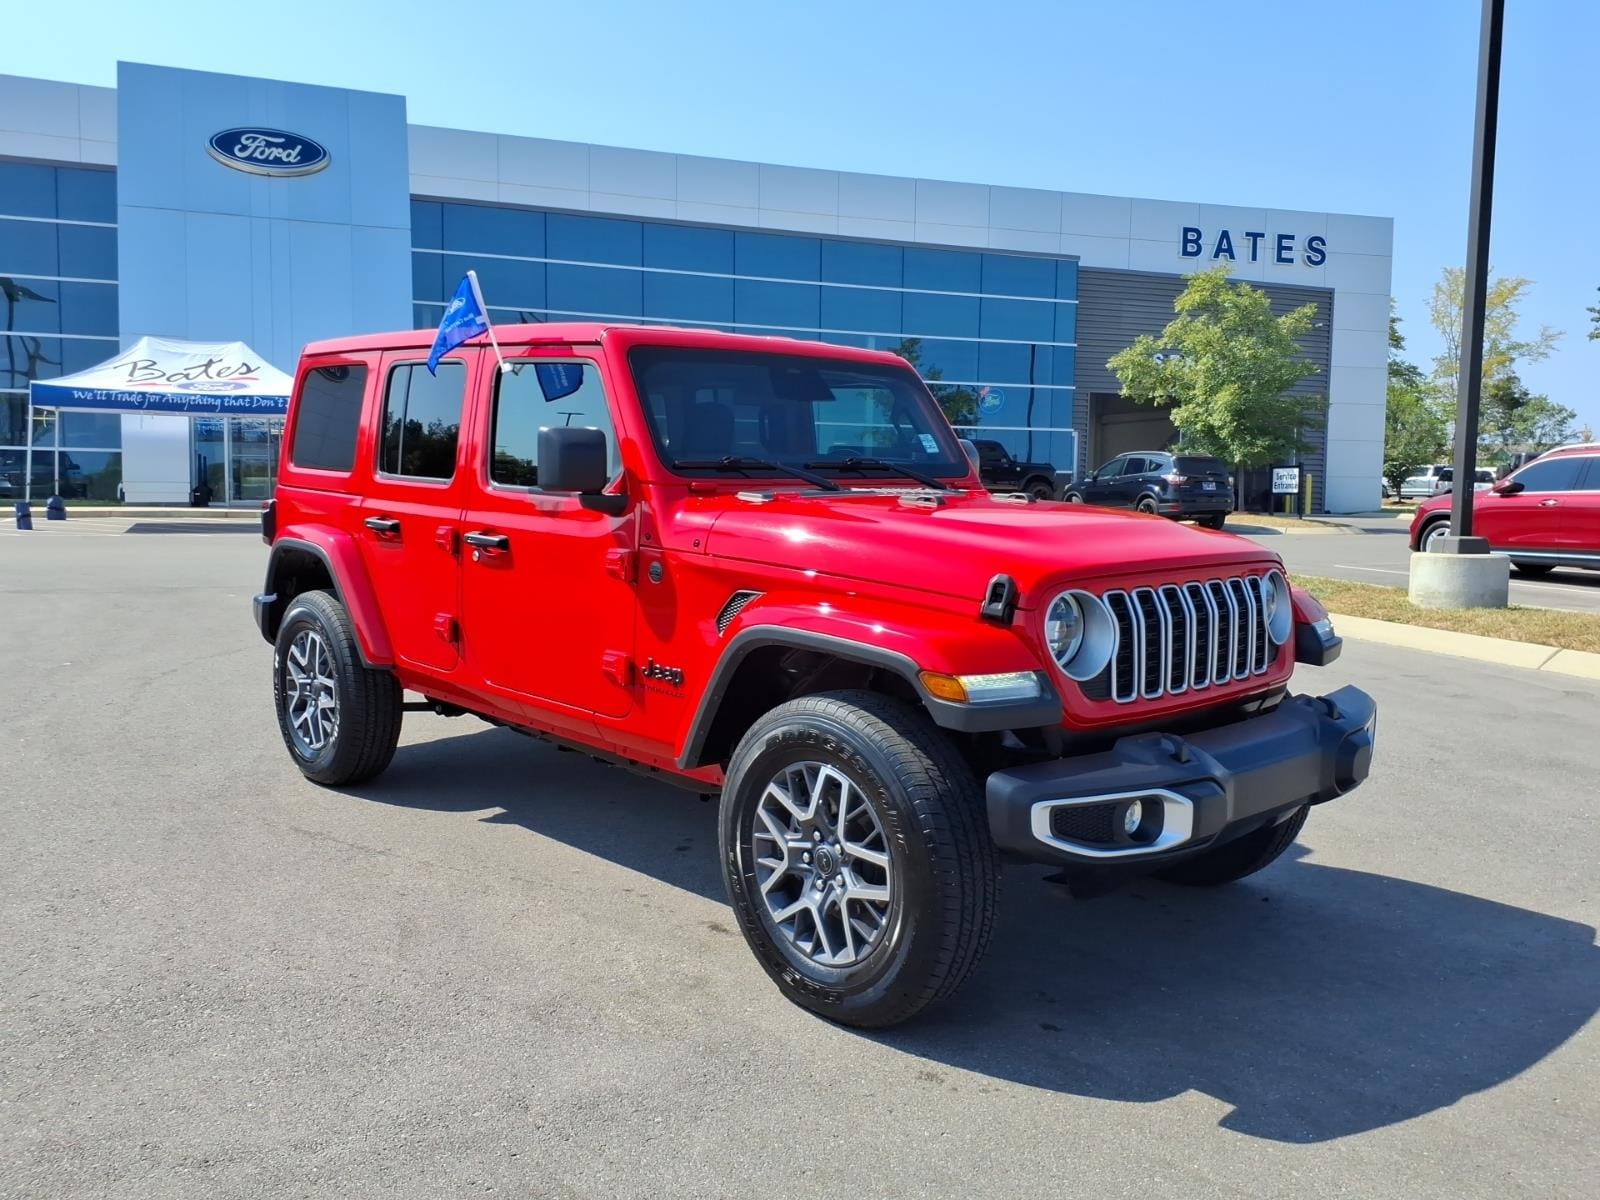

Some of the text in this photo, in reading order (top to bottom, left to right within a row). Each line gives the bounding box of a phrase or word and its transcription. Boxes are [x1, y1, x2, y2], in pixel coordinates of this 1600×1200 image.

[234, 133, 302, 163] Ford
[1181, 226, 1327, 266] BATES
[113, 358, 261, 383] Bates
[72, 390, 107, 400] We'll
[108, 391, 143, 405] Trade
[142, 393, 162, 408] for
[162, 393, 221, 412] Anything
[224, 395, 251, 406] that
[252, 395, 284, 408] Don't
[1275, 472, 1297, 481] Service
[641, 657, 684, 687] Jeep
